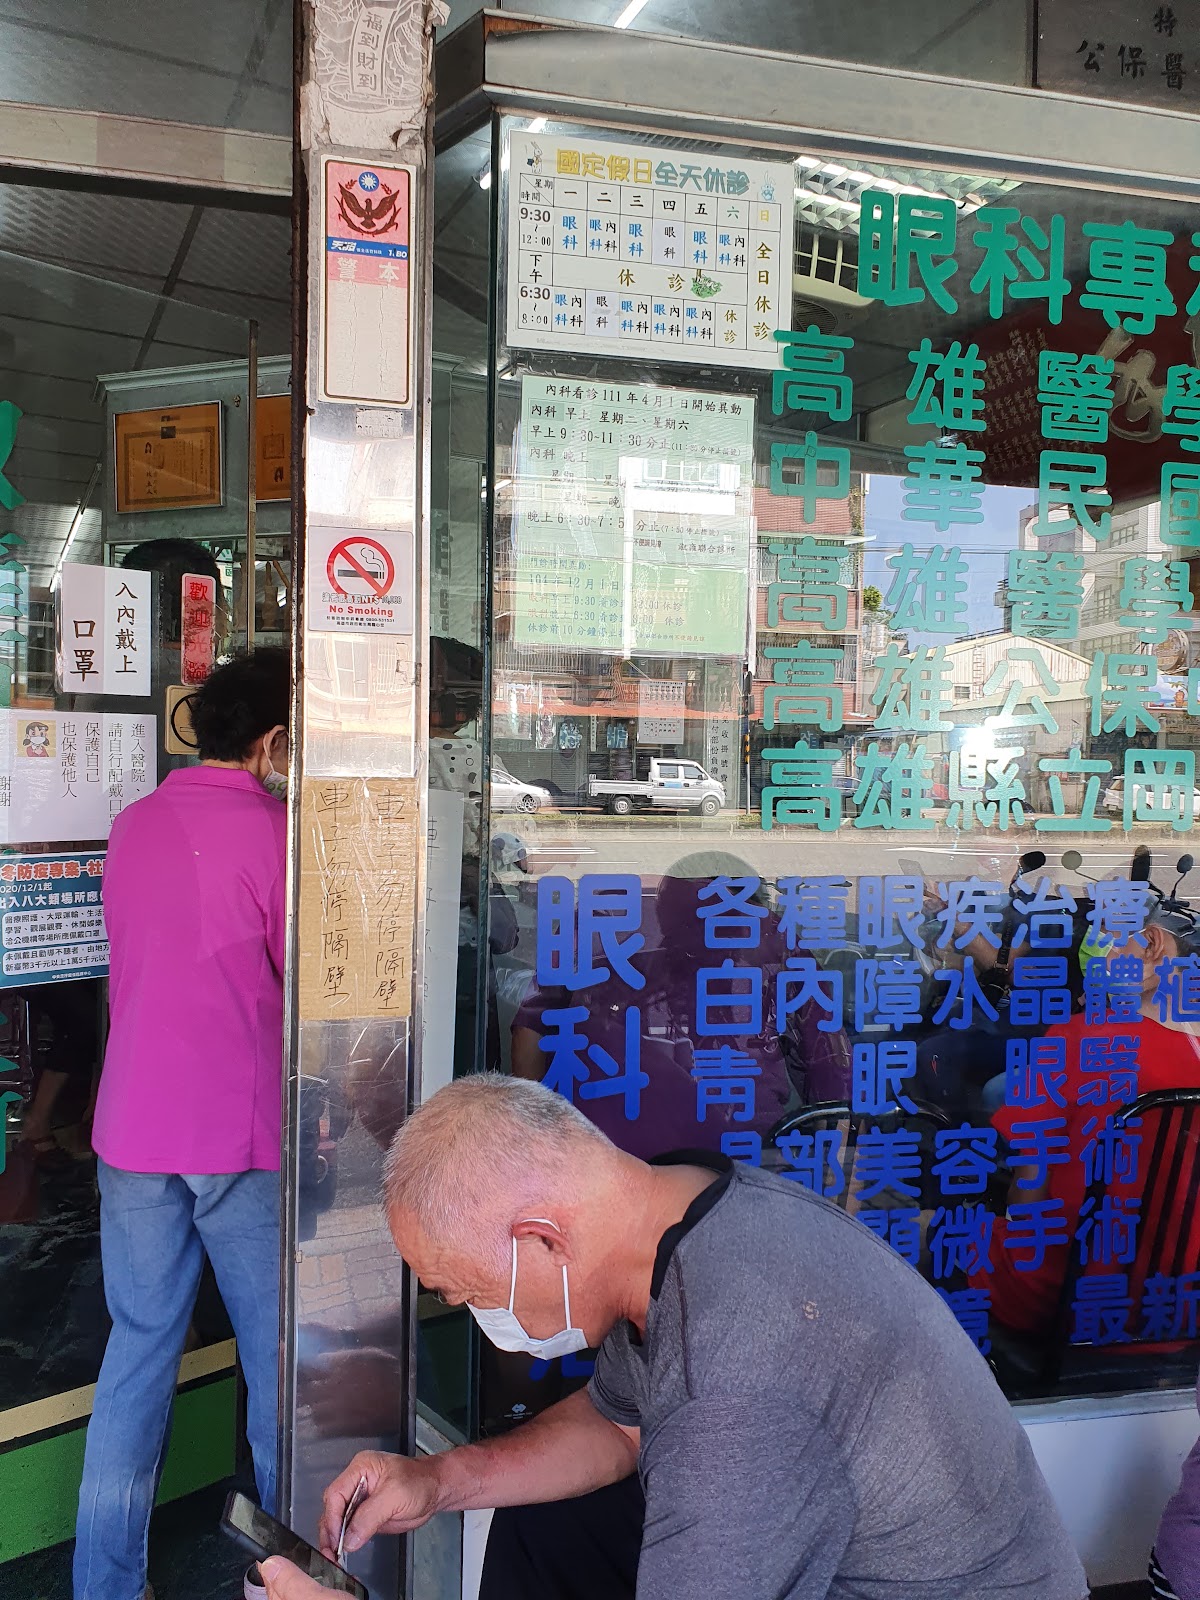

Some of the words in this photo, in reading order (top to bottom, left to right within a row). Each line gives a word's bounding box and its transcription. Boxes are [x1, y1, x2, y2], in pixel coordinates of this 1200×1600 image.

[356, 12, 384, 92] 福到財到
[534, 177, 554, 191] 星期
[555, 147, 751, 197] 國定假日全天休診
[597, 191, 612, 204] 二
[630, 195, 644, 208] 三
[662, 199, 676, 213] 四
[694, 202, 708, 216] 五
[726, 206, 741, 220] 六
[519, 206, 551, 224] 9:30
[760, 209, 770, 222] 日
[521, 232, 552, 247] 12:00
[562, 215, 579, 249] 眼科
[589, 218, 603, 250] 眼科
[604, 220, 618, 253] 內科
[628, 223, 644, 257] 眼科
[664, 226, 677, 259] 眼科
[693, 230, 709, 264] 眼科
[718, 233, 732, 264] 眼科
[733, 234, 746, 268] 內科
[858, 189, 1200, 336] 眼科專
[529, 254, 544, 284] 下午
[617, 267, 687, 293] 休診
[519, 285, 551, 301] 6:30
[753, 241, 773, 340] 全日休診
[521, 313, 549, 327] 8:00
[555, 293, 568, 325] 眼科
[569, 294, 584, 328] 內科
[596, 295, 608, 328] 眼科
[621, 300, 634, 332] 眼科
[636, 301, 649, 335] 內科
[653, 302, 667, 335] 眼科
[668, 304, 682, 338] 內科
[685, 306, 699, 339] 眼科
[700, 307, 714, 341] 內科
[723, 308, 739, 344] 休診
[530, 402, 557, 418] 內科
[529, 446, 556, 461] 內科
[767, 535, 1195, 646] 高雄醫學
[329, 605, 343, 613] No
[347, 606, 393, 617] Smoking
[115, 581, 138, 675] 入內戴上
[70, 618, 100, 683] 口罩
[762, 640, 1200, 738] 高雄公保
[60, 721, 78, 799] 也保護他人
[84, 721, 101, 783] 保護自己
[131, 723, 146, 802] 進入醫院、
[761, 740, 1196, 833] 高雄縣立岡
[0, 858, 106, 882] 冬防疫專案-社
[695, 873, 1151, 951] 各種眼疾治療
[536, 873, 650, 1122] 眼科
[1070, 1271, 1200, 1346] 最新
